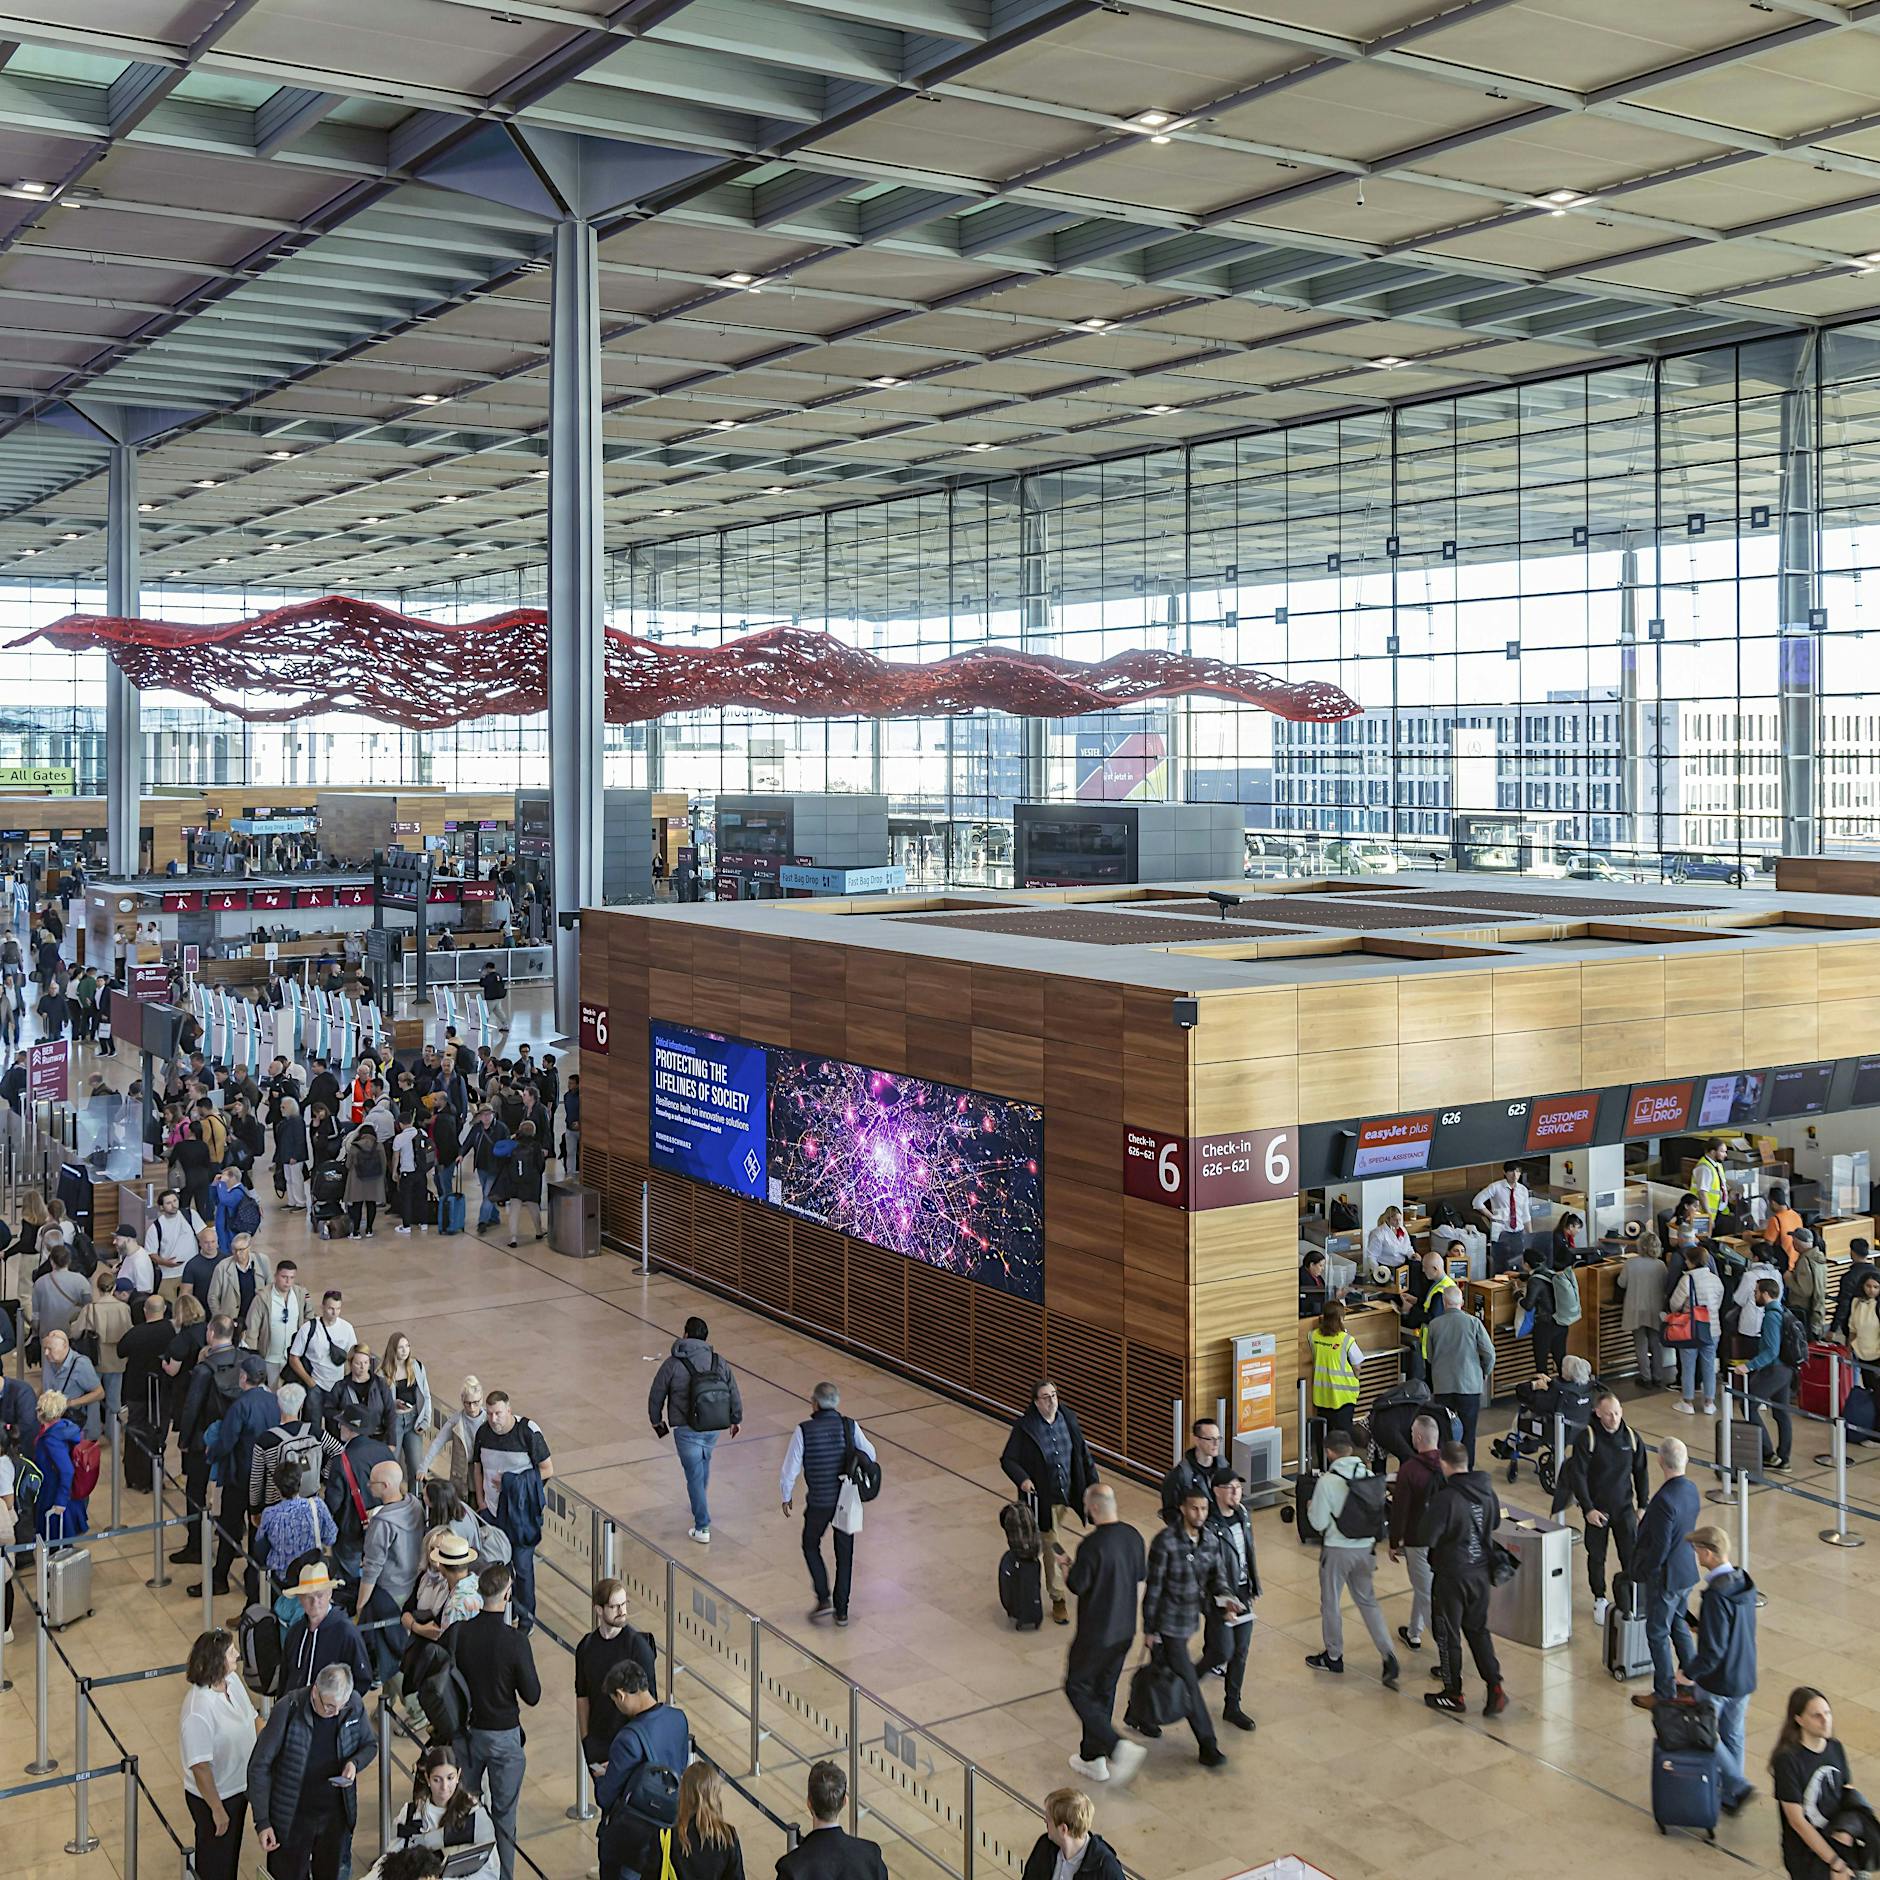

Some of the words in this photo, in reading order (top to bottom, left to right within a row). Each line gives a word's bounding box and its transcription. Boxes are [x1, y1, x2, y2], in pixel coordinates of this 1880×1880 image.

[11, 770, 26, 780] All
[33, 770, 67, 780] Gates
[414, 822, 420, 832] 3
[782, 872, 797, 882] Fast
[797, 874, 805, 885] Bag
[806, 874, 819, 886] Drop
[848, 877, 859, 887] Fast
[859, 876, 870, 887] Bag
[870, 875, 883, 885] Drop
[597, 1011, 607, 1045] 6
[42, 1046, 53, 1055] BER
[42, 1053, 66, 1064] Runway
[655, 1048, 708, 1079] PROTECTING
[709, 1062, 727, 1084] THE
[655, 1070, 696, 1099] LIFELINES
[698, 1082, 710, 1102] OF
[711, 1085, 749, 1113] SOCIETY
[1654, 1096, 1678, 1109] BAG
[655, 1094, 679, 1111] Resilience
[680, 1101, 691, 1114] built
[692, 1108, 698, 1117] on
[699, 1107, 724, 1124] innovative
[725, 1116, 750, 1131] solutions
[1507, 1103, 1526, 1117] 625
[1539, 1109, 1589, 1125] CUSTOMER
[1652, 1108, 1682, 1123] DROP
[1442, 1111, 1461, 1125] 626
[1364, 1125, 1407, 1140] easyJet
[1409, 1122, 1428, 1136] plus
[1536, 1122, 1575, 1136] SERVICE
[1128, 1133, 1155, 1148] Check-in
[1158, 1142, 1180, 1193] 6
[1202, 1139, 1251, 1158] Check-in
[1265, 1133, 1290, 1185] 6
[1369, 1155, 1391, 1164] SPECIAL
[1392, 1151, 1425, 1160] ASSISTANCE
[144, 1670, 158, 1678] BER
[76, 1771, 90, 1781] BER
